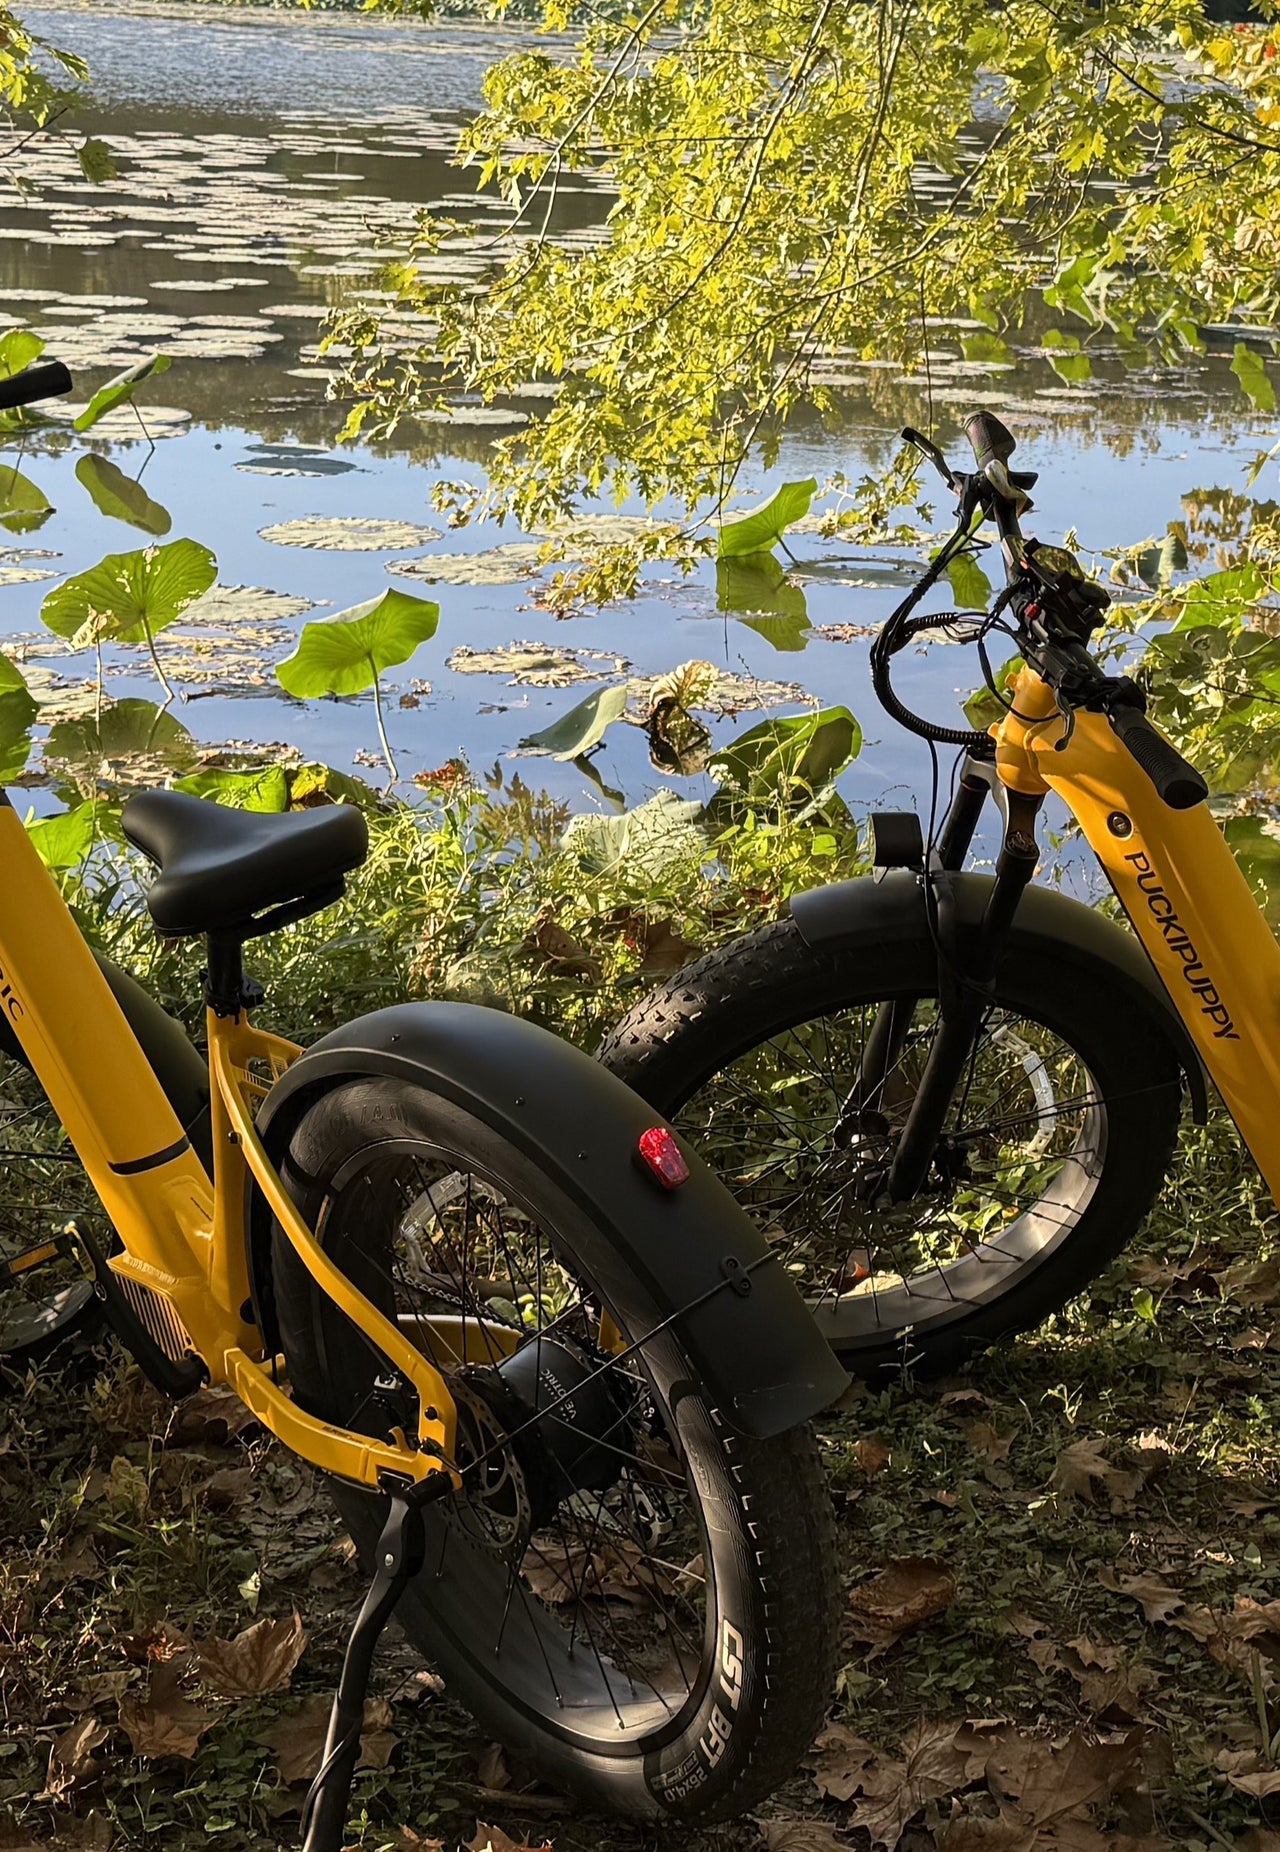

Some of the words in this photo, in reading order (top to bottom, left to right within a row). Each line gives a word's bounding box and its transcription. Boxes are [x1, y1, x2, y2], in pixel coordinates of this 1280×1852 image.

[1124, 851, 1240, 1040] PUCKIPUPPY
[721, 1619, 744, 1711] CST
[699, 1703, 733, 1769] BFT
[663, 1766, 708, 1802] 26x4.0
